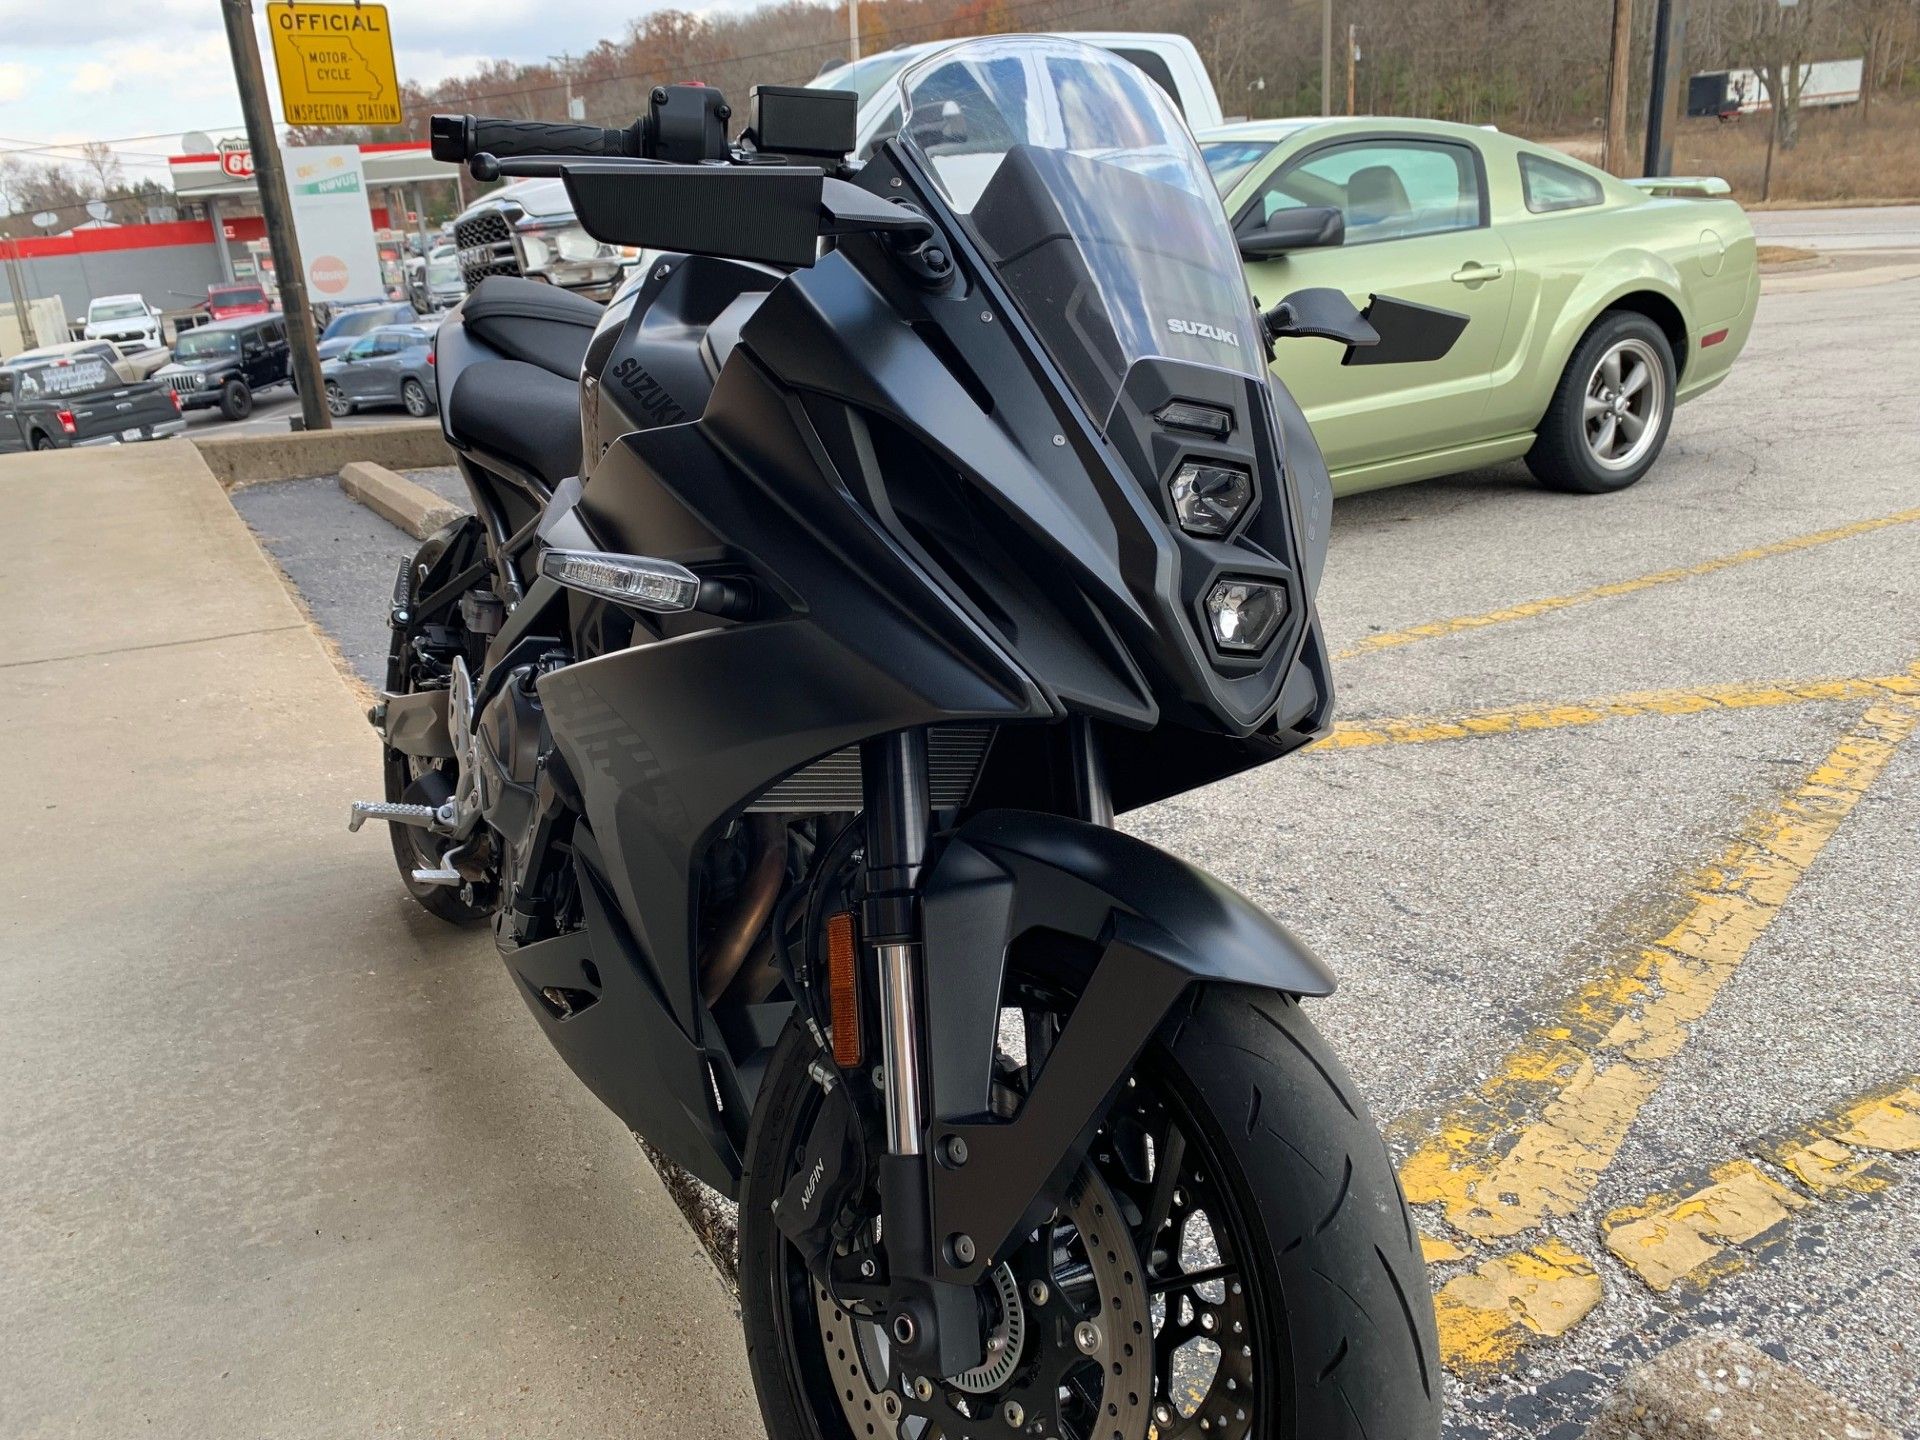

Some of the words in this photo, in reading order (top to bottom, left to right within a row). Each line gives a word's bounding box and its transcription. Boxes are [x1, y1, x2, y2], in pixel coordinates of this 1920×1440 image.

[280, 13, 380, 32] OFFICIAL
[309, 51, 352, 64] MOTOR-
[317, 68, 351, 81] CYCLE
[289, 103, 349, 121] INSPECTION
[357, 103, 397, 121] STATION
[229, 154, 254, 170] 66
[1167, 318, 1240, 347] SUZUKI
[612, 357, 688, 426] SUZUKI
